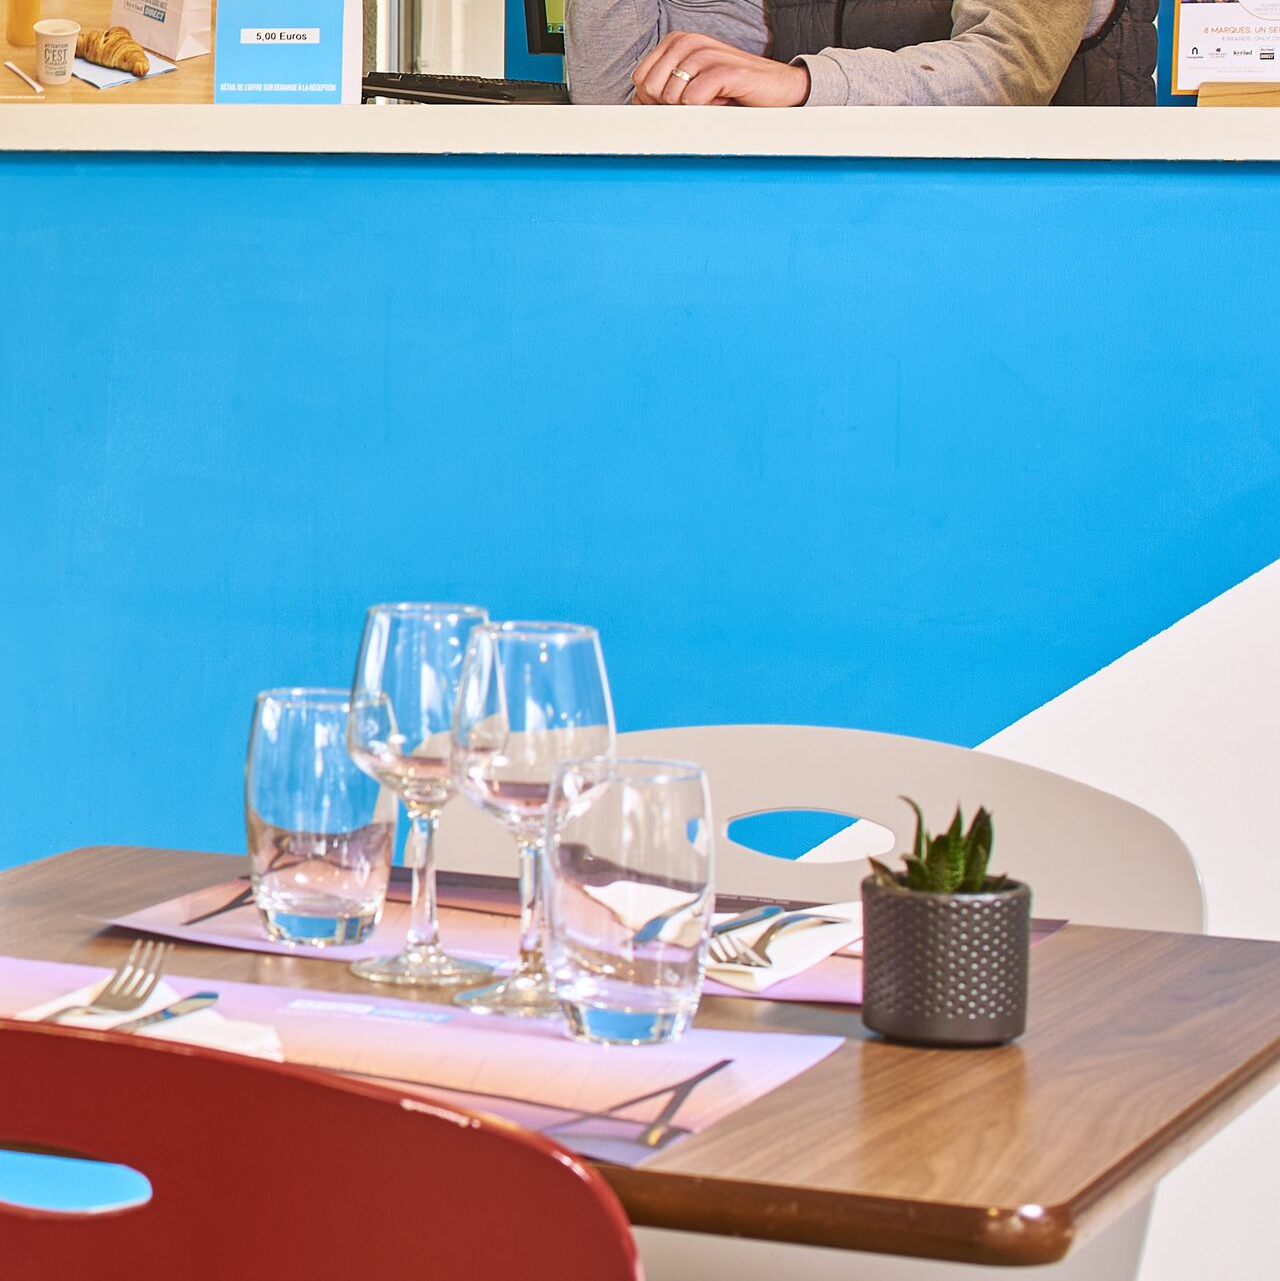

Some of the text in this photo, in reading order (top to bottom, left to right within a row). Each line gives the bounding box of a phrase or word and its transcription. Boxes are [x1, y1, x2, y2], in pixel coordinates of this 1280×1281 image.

[256, 32, 307, 42] 5,00 Euros
[44, 48, 69, 62] C'EST
